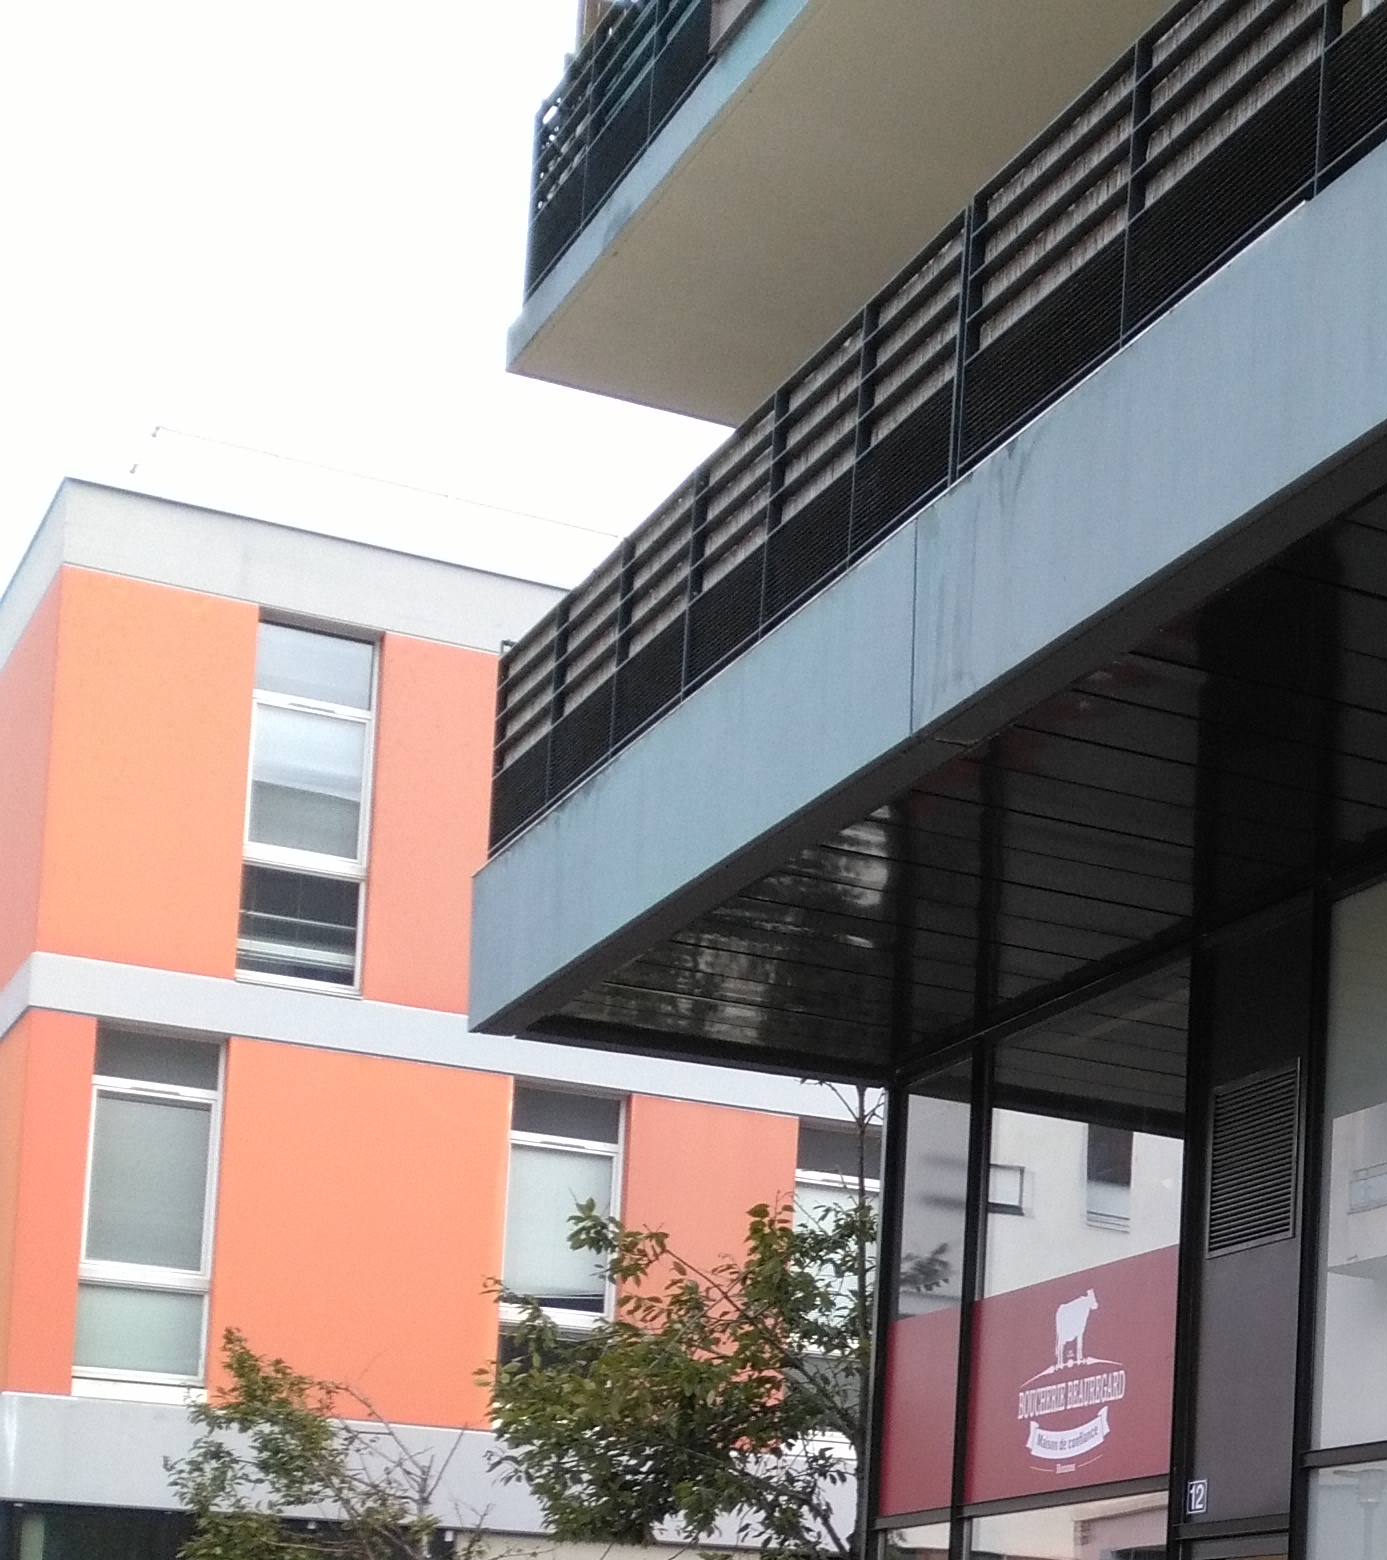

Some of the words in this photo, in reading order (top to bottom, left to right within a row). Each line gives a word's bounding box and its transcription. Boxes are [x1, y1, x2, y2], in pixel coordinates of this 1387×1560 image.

[1017, 1383, 1066, 1420] BOUCHERIE
[1066, 1369, 1126, 1410] BEAUREGARD
[1189, 1484, 1205, 1510] 12
